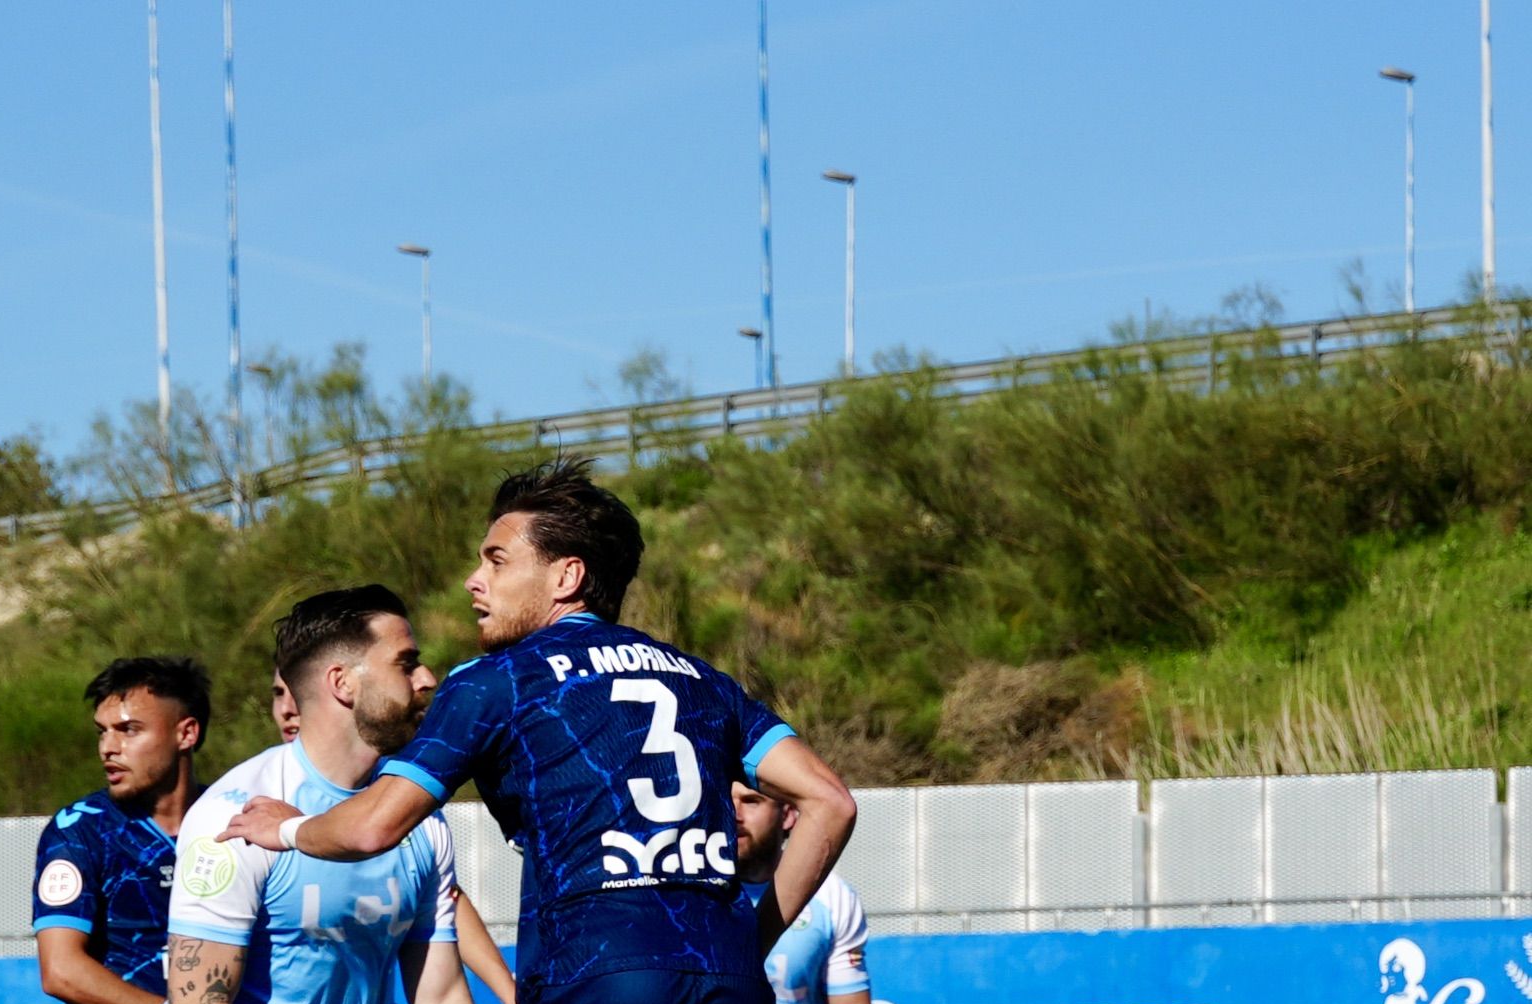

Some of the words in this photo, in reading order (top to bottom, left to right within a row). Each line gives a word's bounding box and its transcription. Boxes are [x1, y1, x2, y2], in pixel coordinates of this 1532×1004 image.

[588, 643, 701, 680] MORILLO
[610, 679, 702, 823] 3
[601, 875, 659, 889] Marbella
